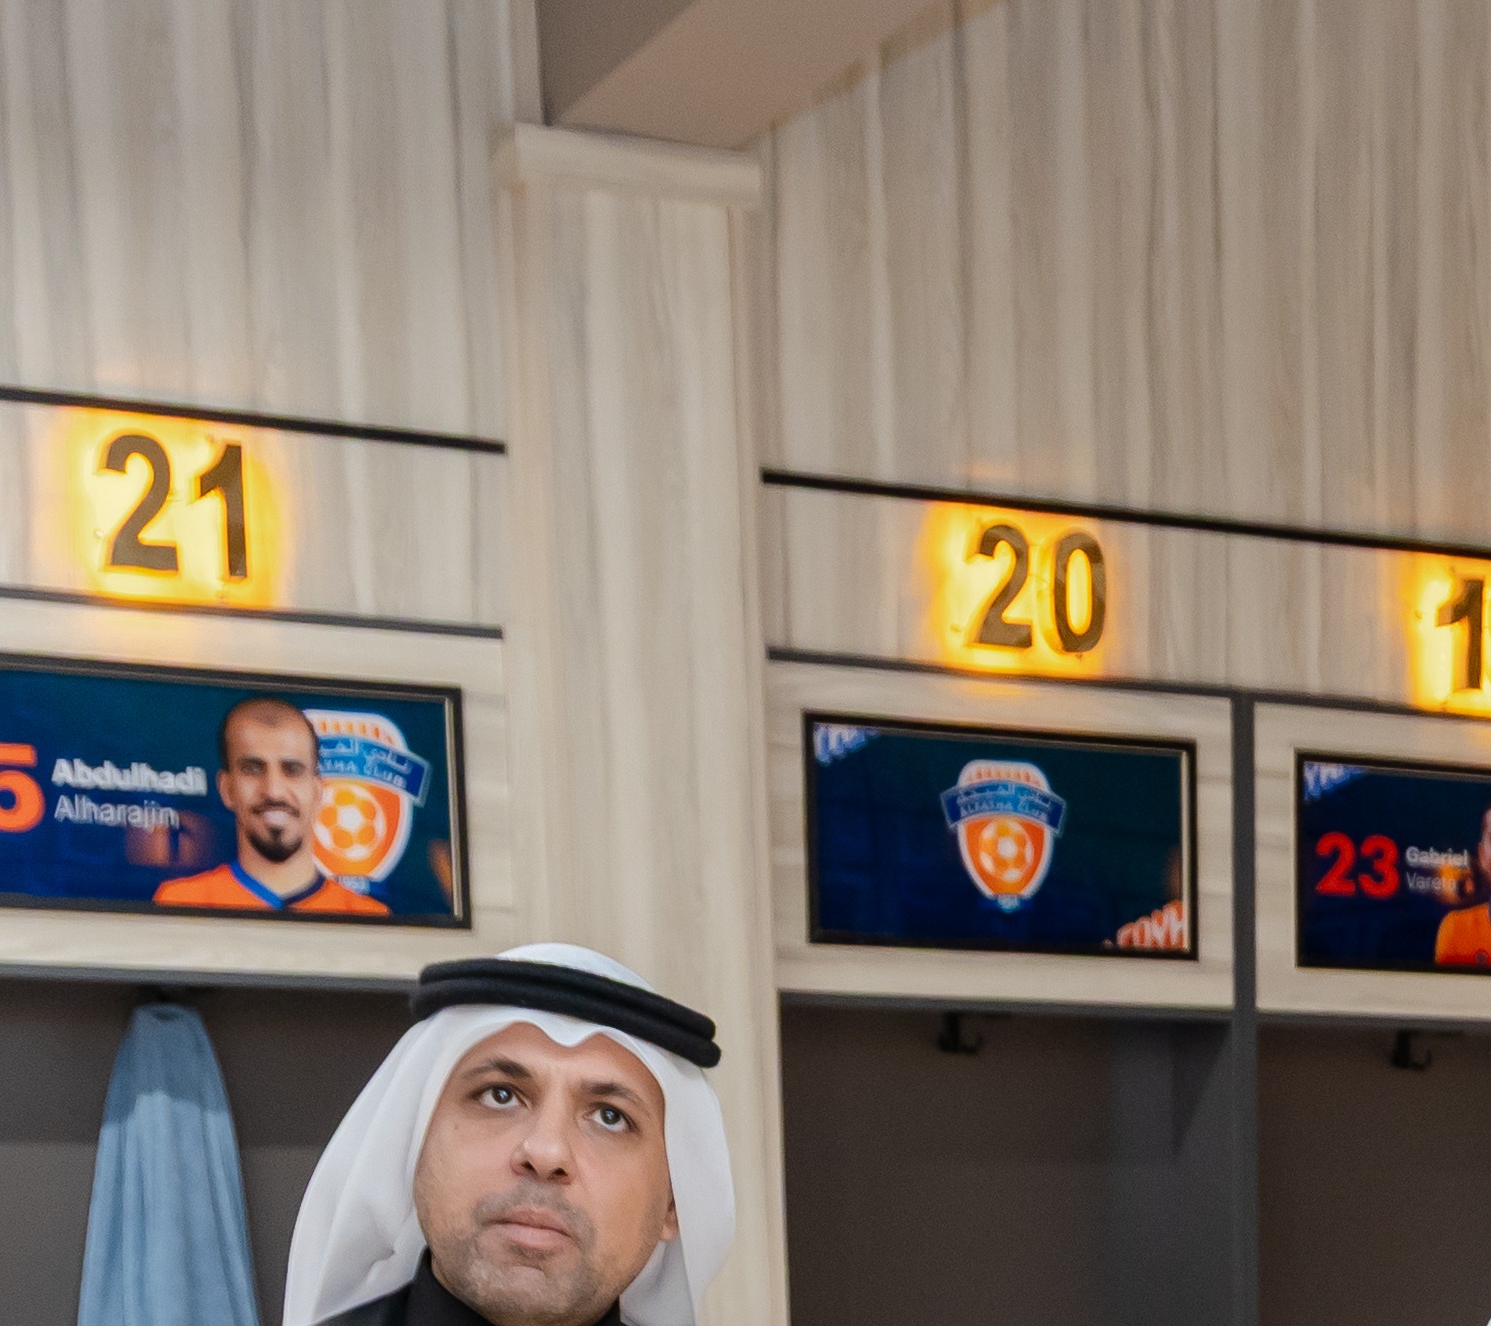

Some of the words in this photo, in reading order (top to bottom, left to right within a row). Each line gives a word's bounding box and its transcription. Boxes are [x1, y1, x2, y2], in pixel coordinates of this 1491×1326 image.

[102, 432, 249, 578] 21
[976, 523, 1108, 653] 20
[50, 757, 208, 797] Abdulhadi
[54, 794, 181, 833] Alharajin
[1314, 831, 1401, 899] 23
[1405, 845, 1469, 868] Gabriel
